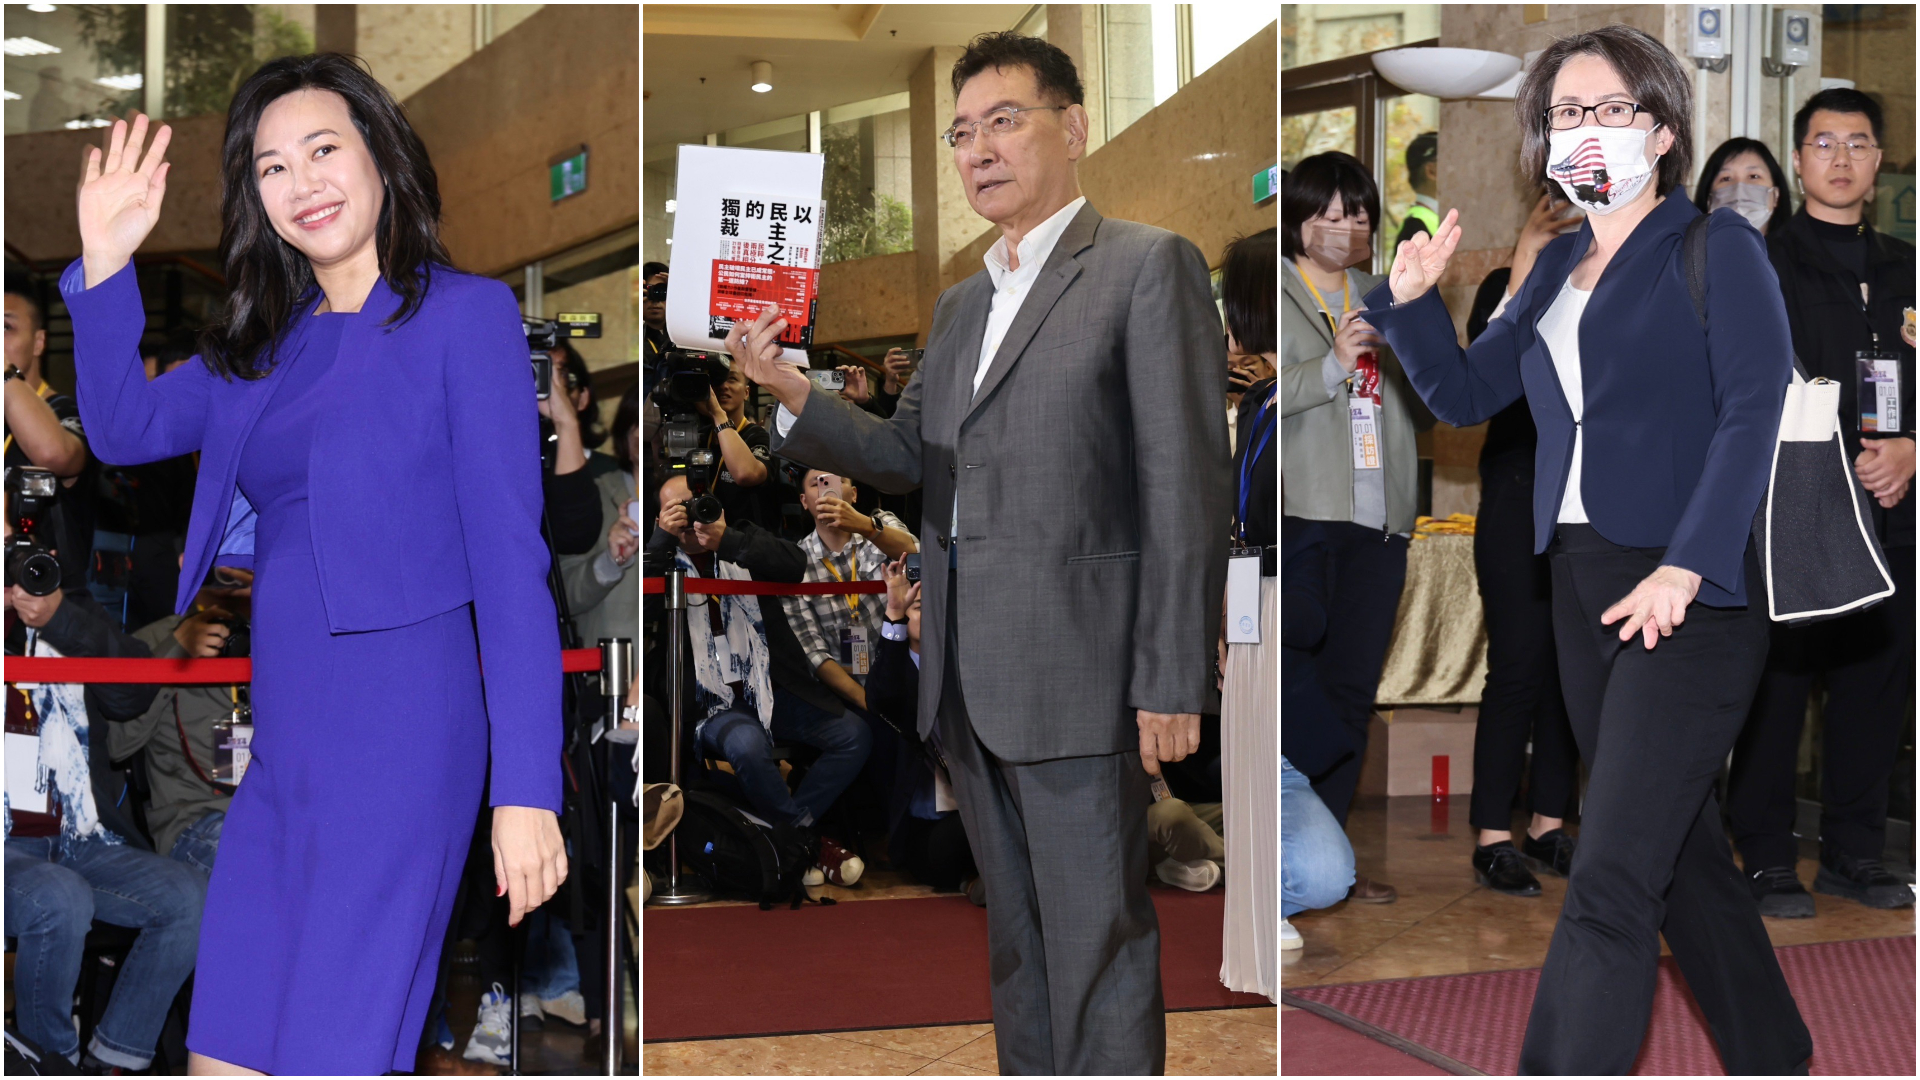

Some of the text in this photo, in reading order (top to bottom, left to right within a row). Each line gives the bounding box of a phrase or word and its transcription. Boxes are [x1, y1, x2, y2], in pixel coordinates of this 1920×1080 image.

[720, 198, 741, 237] 獨裁
[745, 199, 765, 220] 的
[793, 205, 812, 224] 以
[1354, 423, 1373, 434] 01.01
